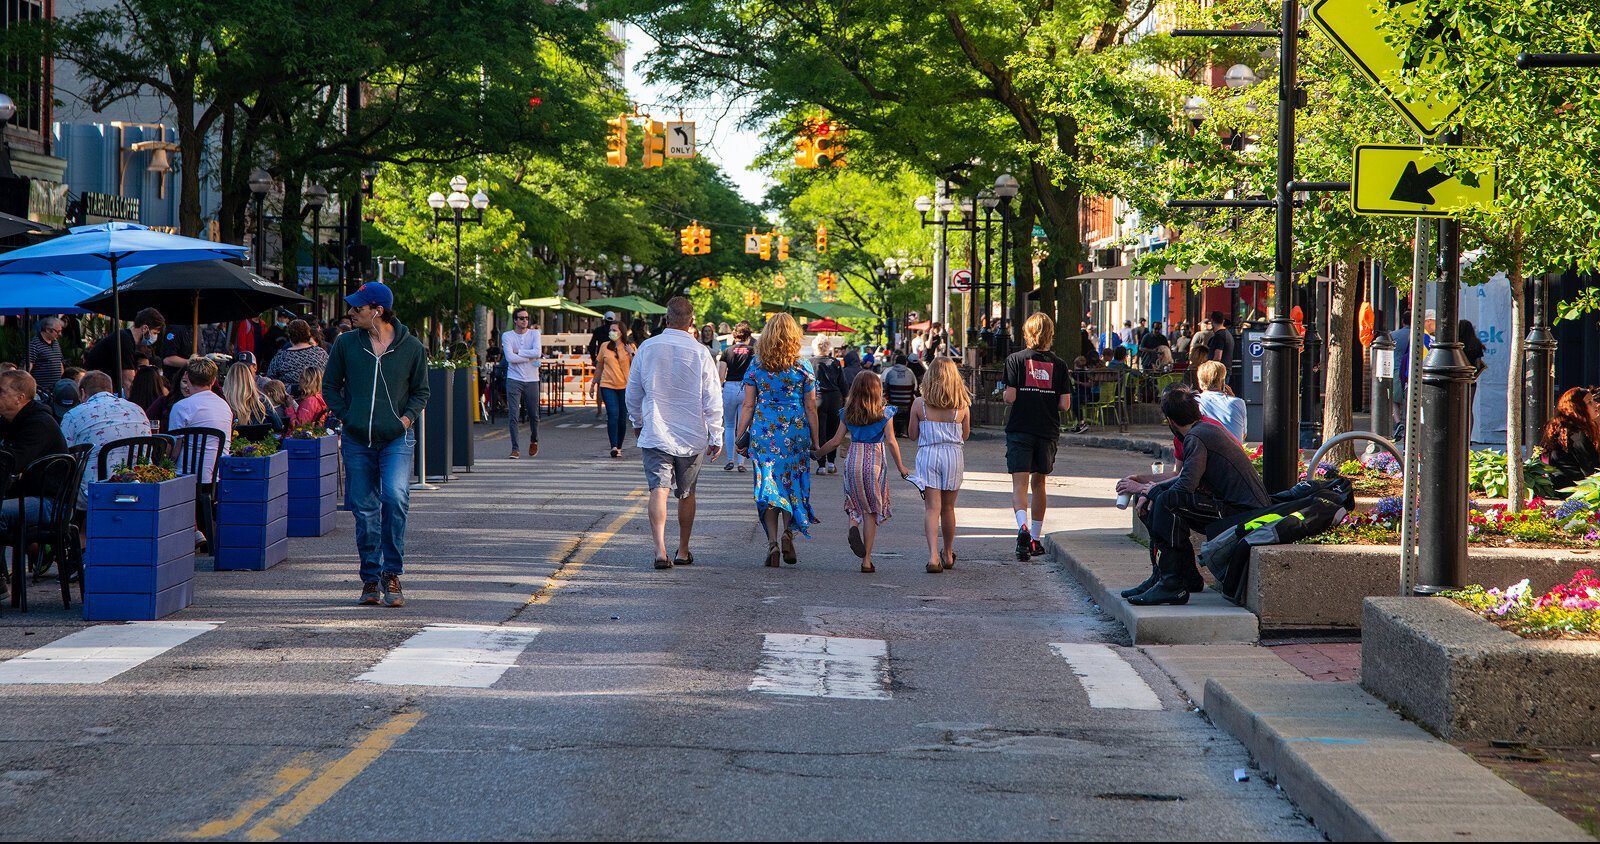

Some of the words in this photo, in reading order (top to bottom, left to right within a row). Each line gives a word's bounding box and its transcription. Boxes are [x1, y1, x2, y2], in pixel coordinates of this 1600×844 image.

[86, 191, 119, 217] STARBUCKS
[119, 196, 139, 220] COFFEE
[1478, 326, 1504, 343] ek
[1253, 344, 1262, 355] P
